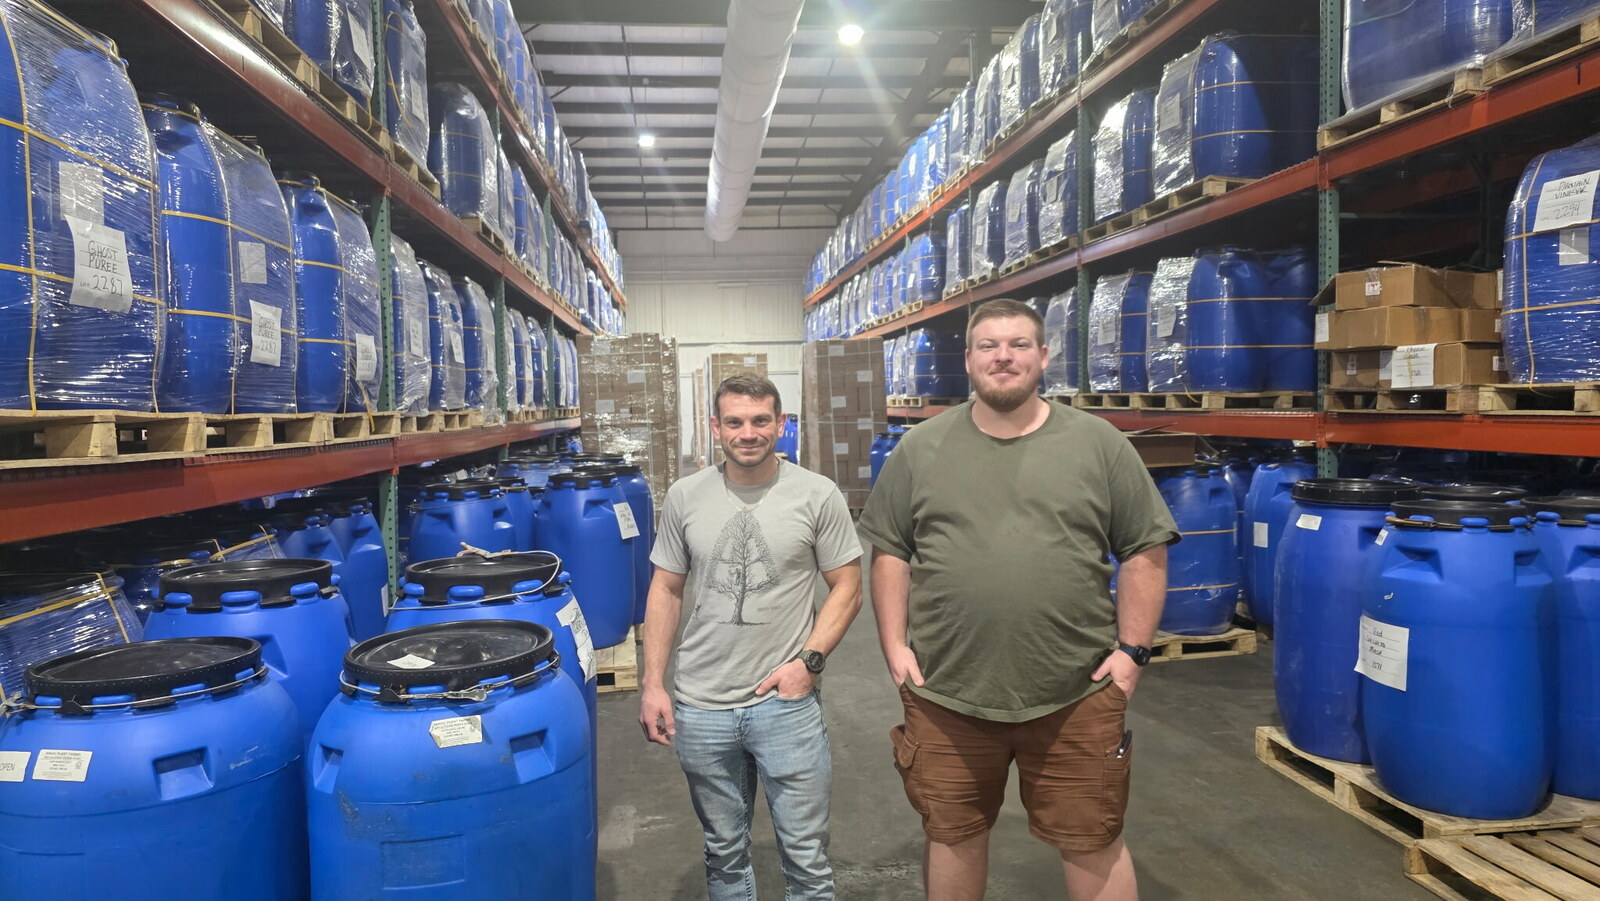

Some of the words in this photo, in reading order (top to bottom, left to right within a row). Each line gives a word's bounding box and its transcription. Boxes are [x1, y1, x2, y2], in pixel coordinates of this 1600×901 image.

[1553, 202, 1581, 220] 2294
[88, 240, 118, 260] GHOST
[89, 254, 118, 274] PUREE
[93, 275, 123, 296] 2287
